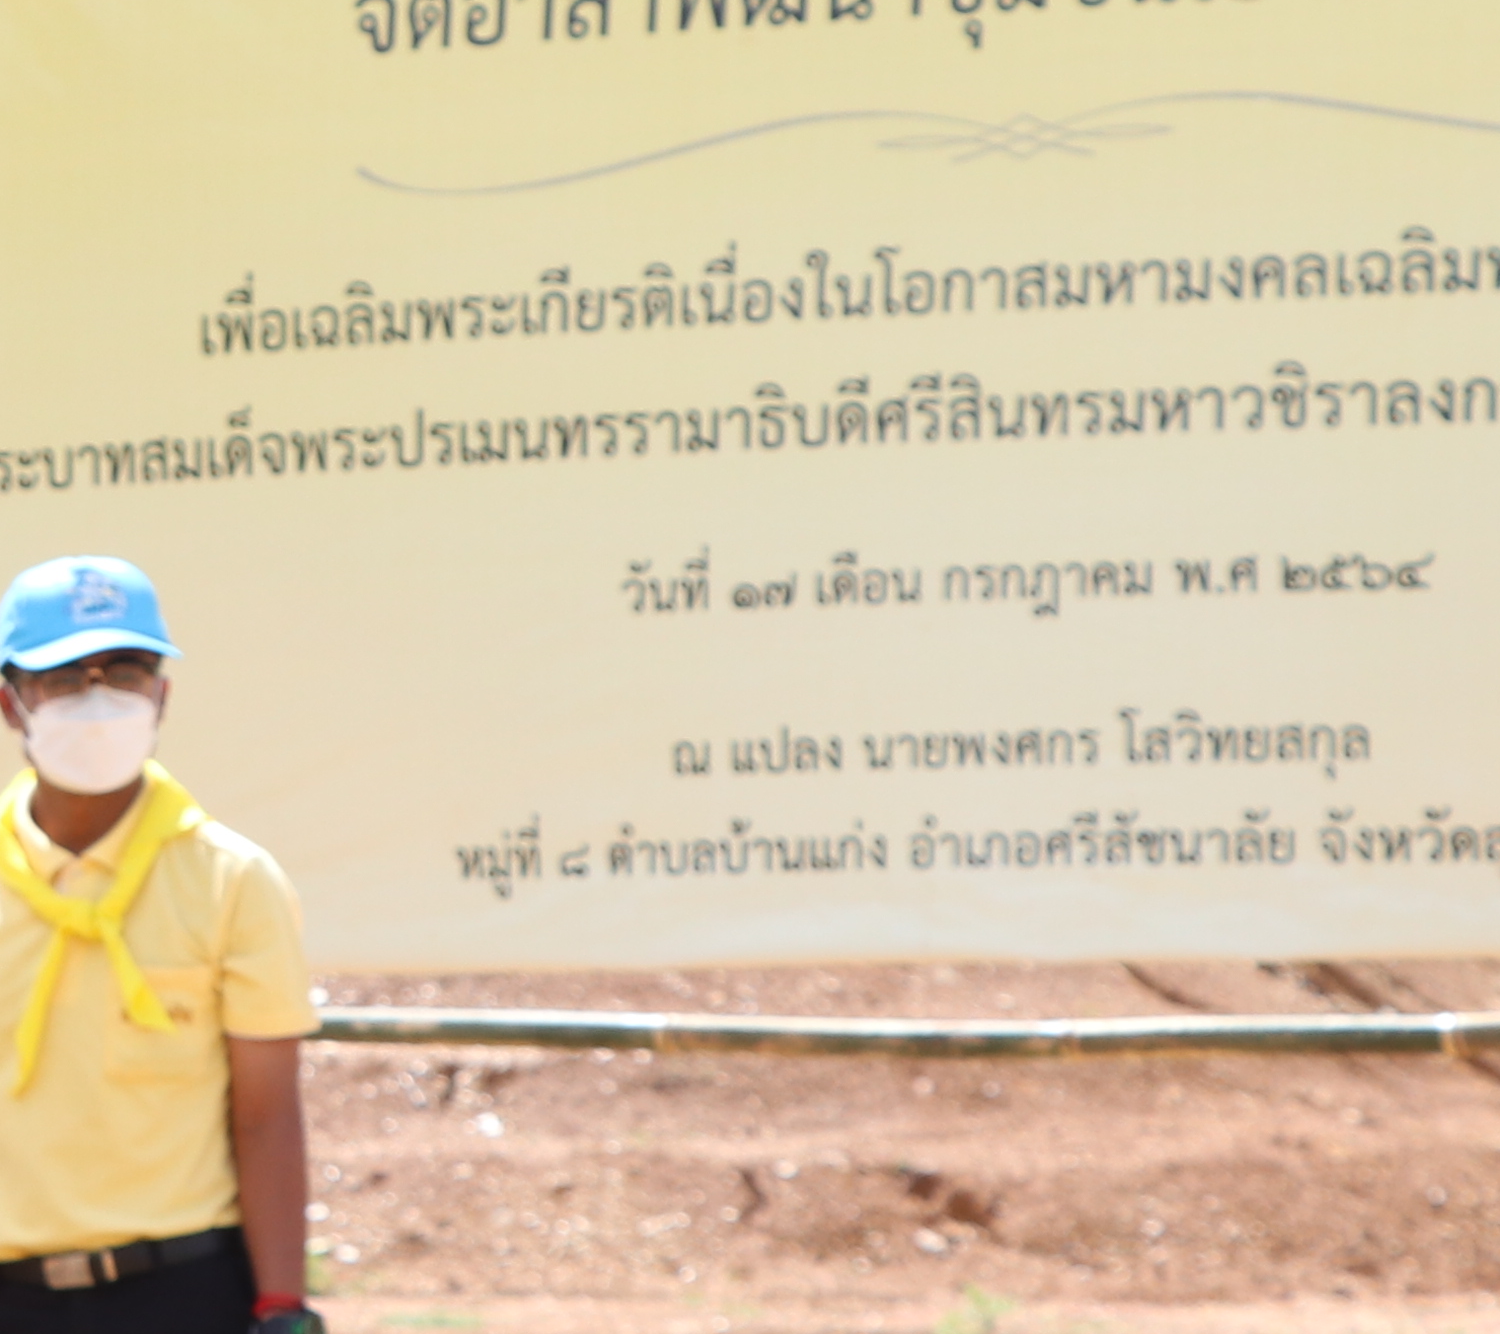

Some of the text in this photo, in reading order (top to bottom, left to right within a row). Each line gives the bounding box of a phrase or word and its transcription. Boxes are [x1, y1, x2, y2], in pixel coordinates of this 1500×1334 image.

[620, 543, 710, 615] วันที่
[729, 570, 798, 611] ๑๗
[813, 548, 923, 608] เดือน
[942, 560, 1154, 619] กรกฎาคม
[1278, 551, 1437, 594] ๒๕๖๔
[670, 706, 1372, 781] ณ แปลง นายพงศกร โสวิทยสกุล
[454, 811, 543, 900] หมู่ที่
[605, 816, 888, 877] ตำบลบ้านแก่ง
[908, 807, 1297, 872] อำเภอศรีสัชนาลัย
